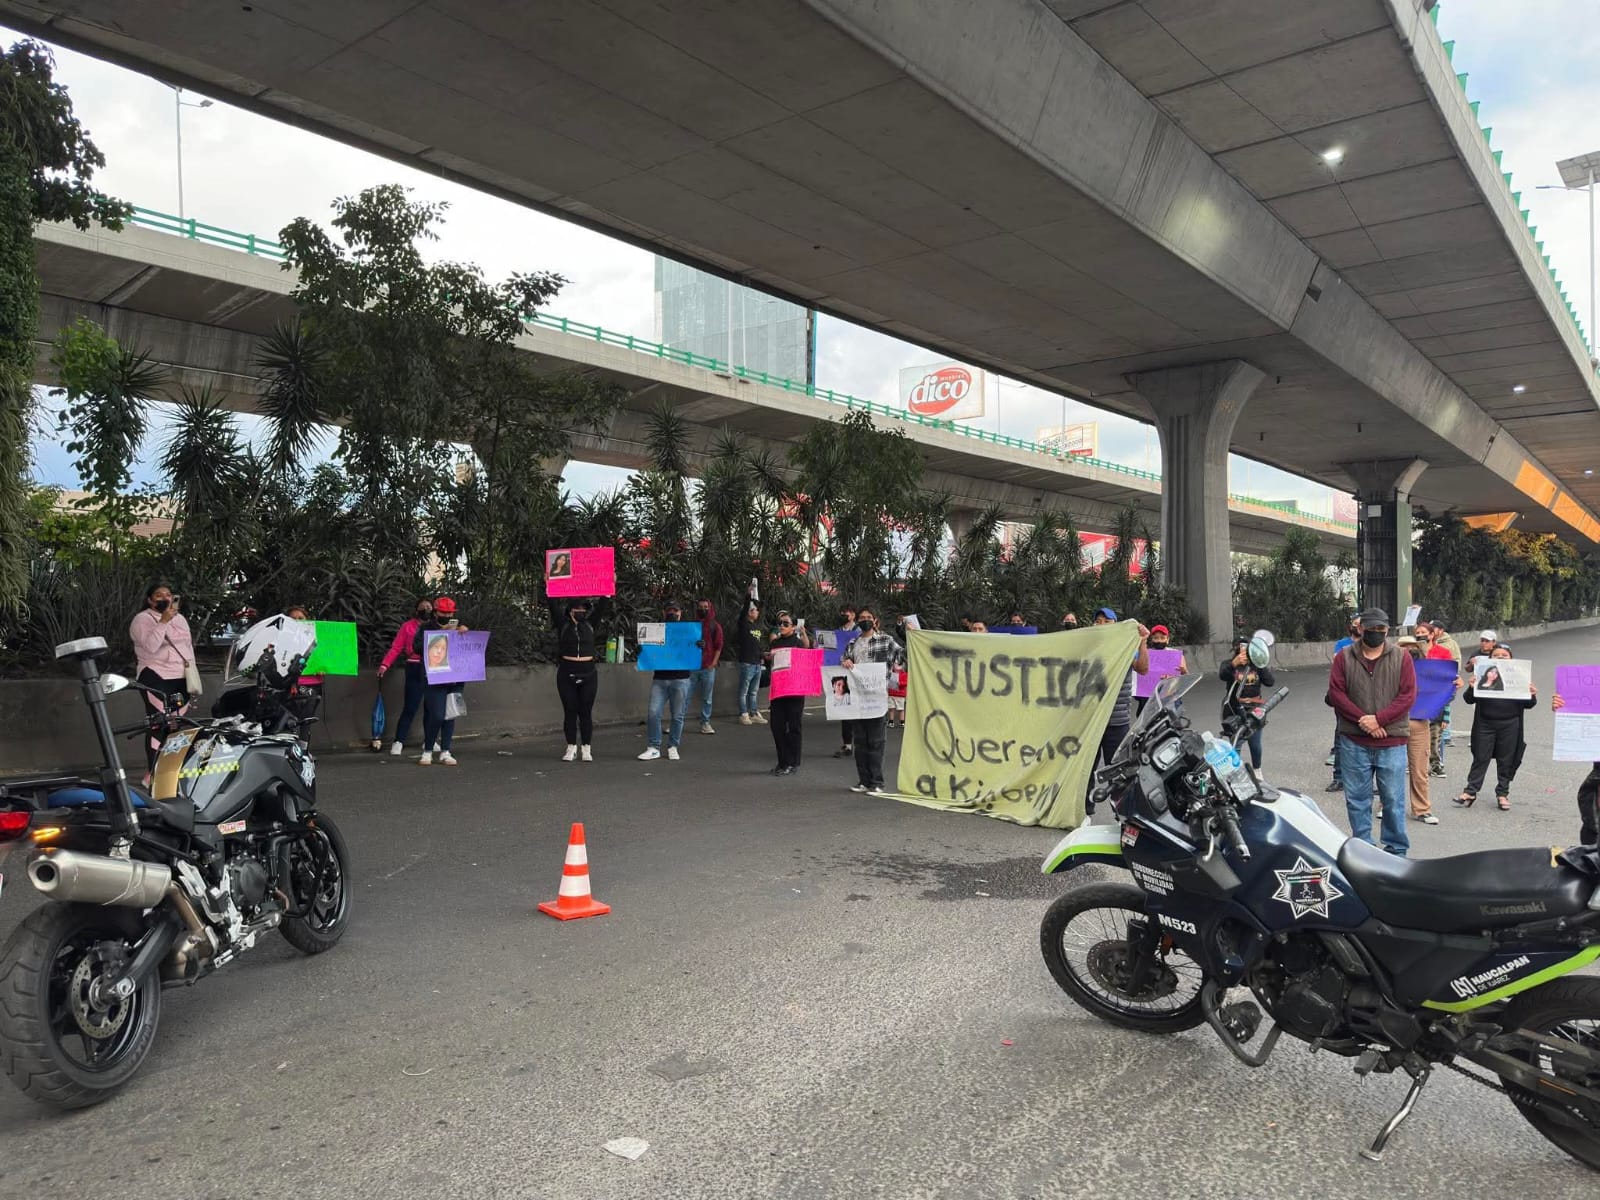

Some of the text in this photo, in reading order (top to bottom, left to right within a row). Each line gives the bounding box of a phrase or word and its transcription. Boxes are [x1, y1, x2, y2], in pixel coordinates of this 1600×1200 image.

[911, 375, 969, 404] dico
[916, 774, 937, 798] a
[1480, 901, 1547, 916] Kawasaki
[1158, 913, 1196, 935] M523
[1470, 955, 1530, 986] NAUCALPAN
[1478, 983, 1488, 991] DE
